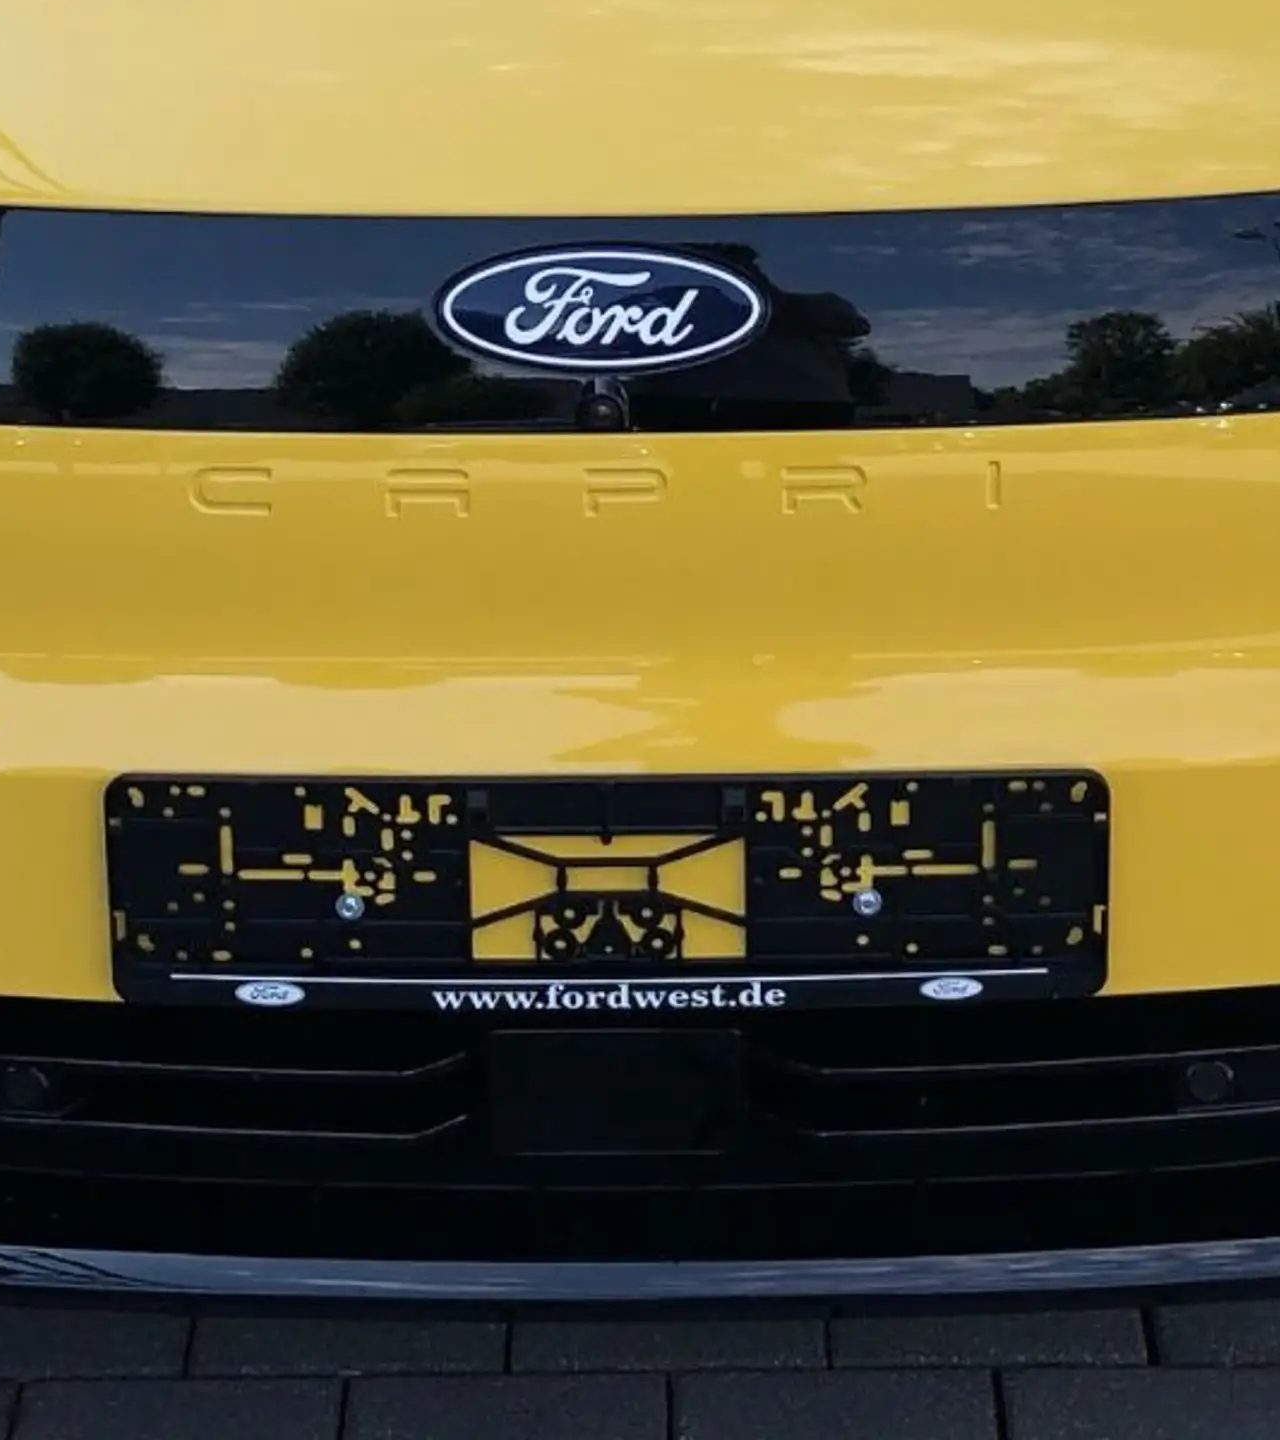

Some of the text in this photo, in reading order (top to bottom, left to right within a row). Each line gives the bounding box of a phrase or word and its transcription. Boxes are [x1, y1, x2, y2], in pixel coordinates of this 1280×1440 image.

[504, 266, 700, 347] Ford
[188, 460, 1003, 518] CAPRI
[431, 981, 787, 1010] www.fordwest.de
